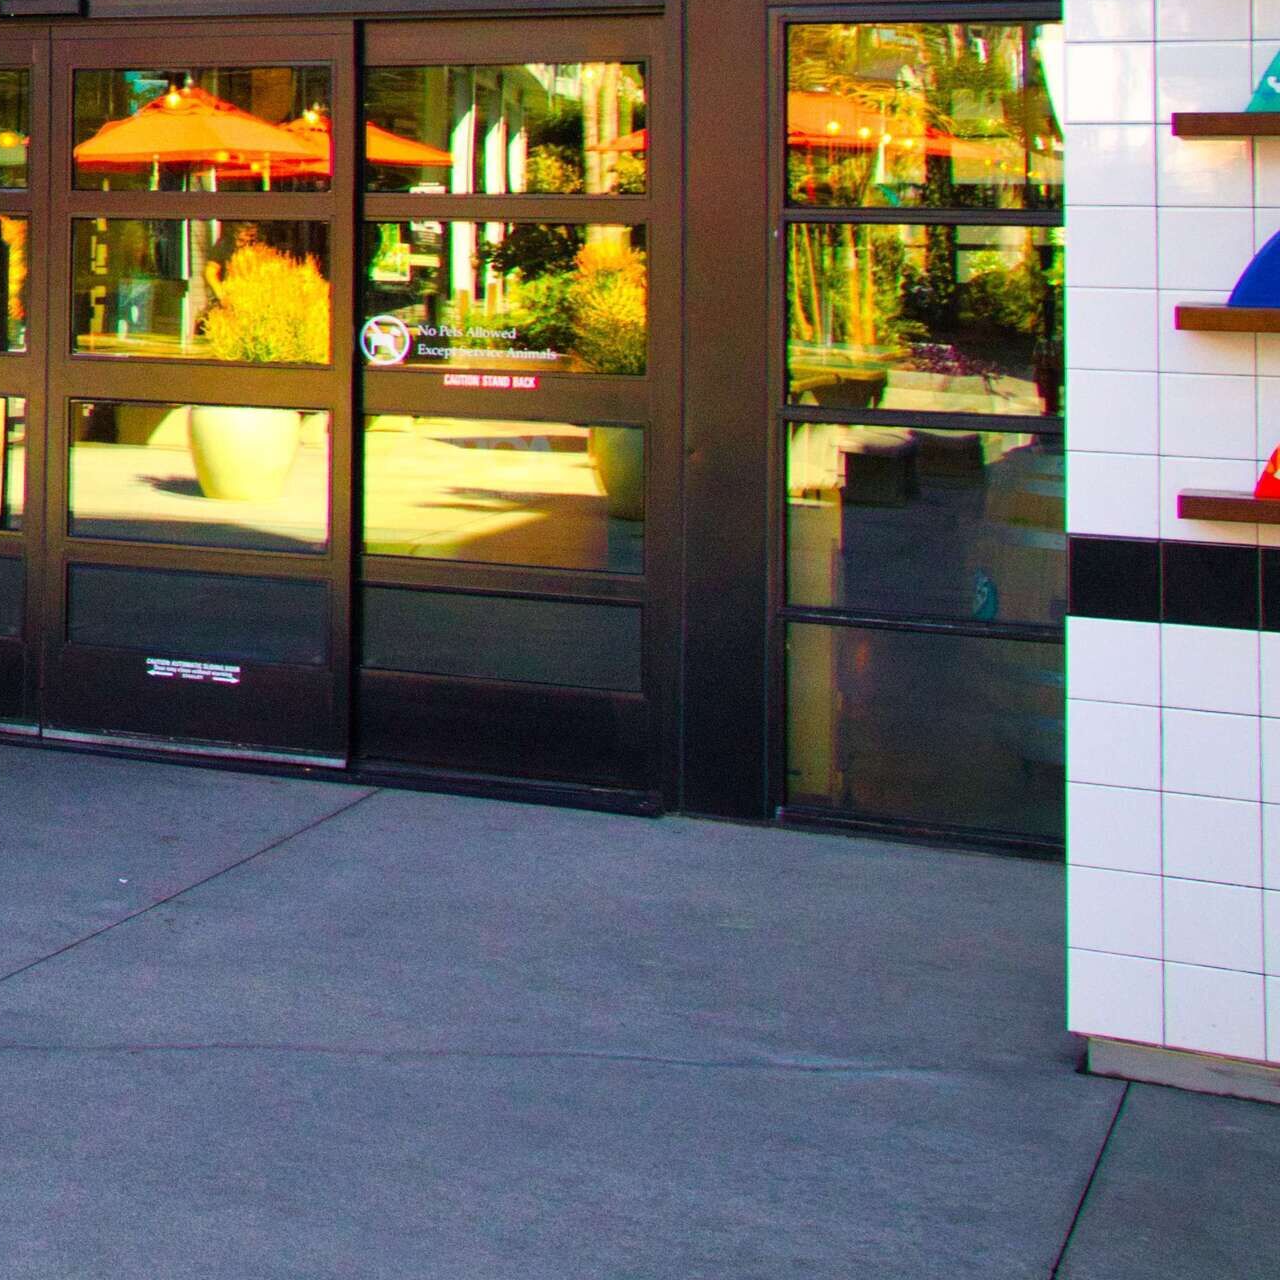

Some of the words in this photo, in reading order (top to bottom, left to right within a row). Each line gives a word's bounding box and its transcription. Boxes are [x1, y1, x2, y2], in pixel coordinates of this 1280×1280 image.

[417, 324, 437, 336] No
[439, 325, 463, 337] Pets
[466, 326, 517, 339] Allowed
[506, 347, 558, 360] Animals
[482, 375, 510, 387] STAND
[513, 376, 536, 388] BACK
